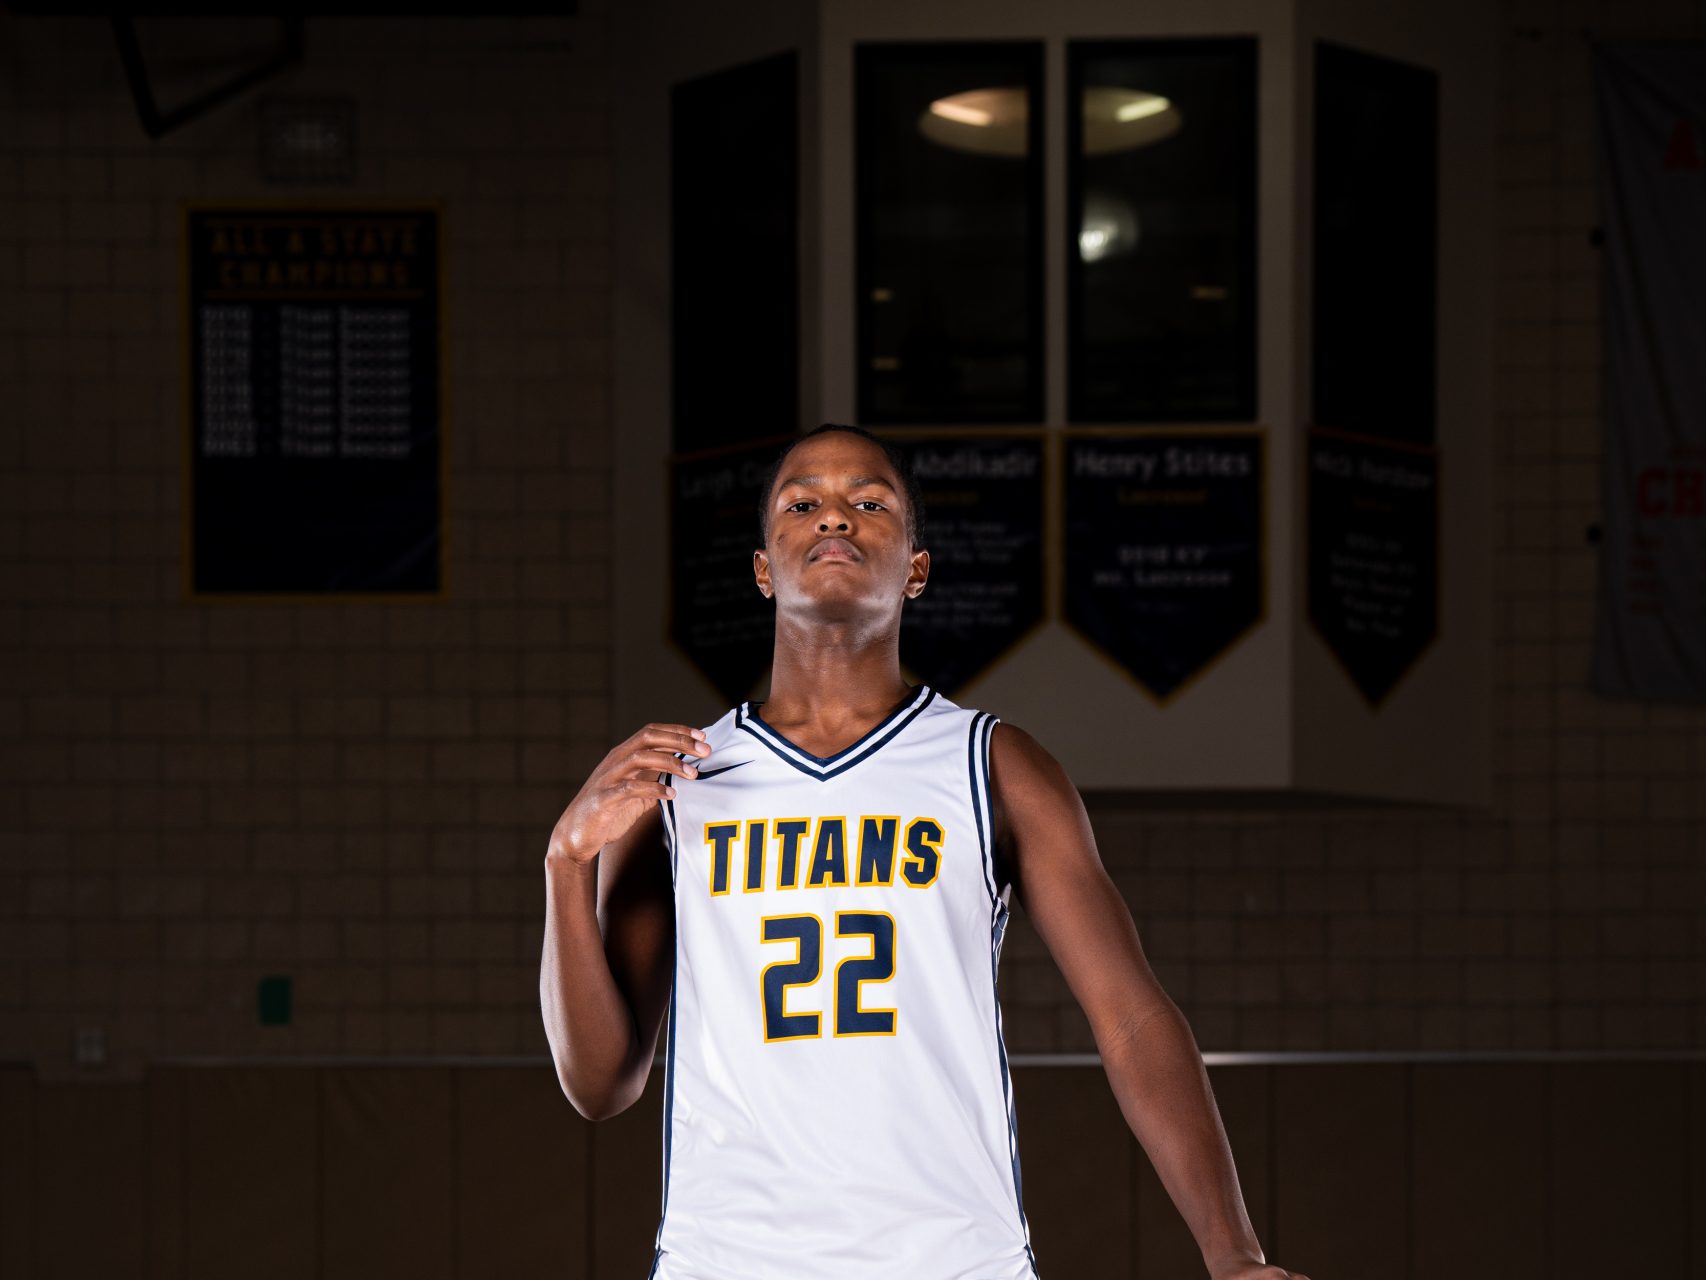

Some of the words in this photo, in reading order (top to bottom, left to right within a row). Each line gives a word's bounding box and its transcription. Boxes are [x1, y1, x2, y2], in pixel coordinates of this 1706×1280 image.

[209, 226, 272, 256] ALL
[319, 226, 418, 256] STATE
[219, 259, 412, 288] CHAMPIONS
[1072, 447, 1159, 484] Henry
[1163, 445, 1252, 478] Stites
[704, 815, 946, 897] TITANS
[760, 910, 897, 1044] 22
